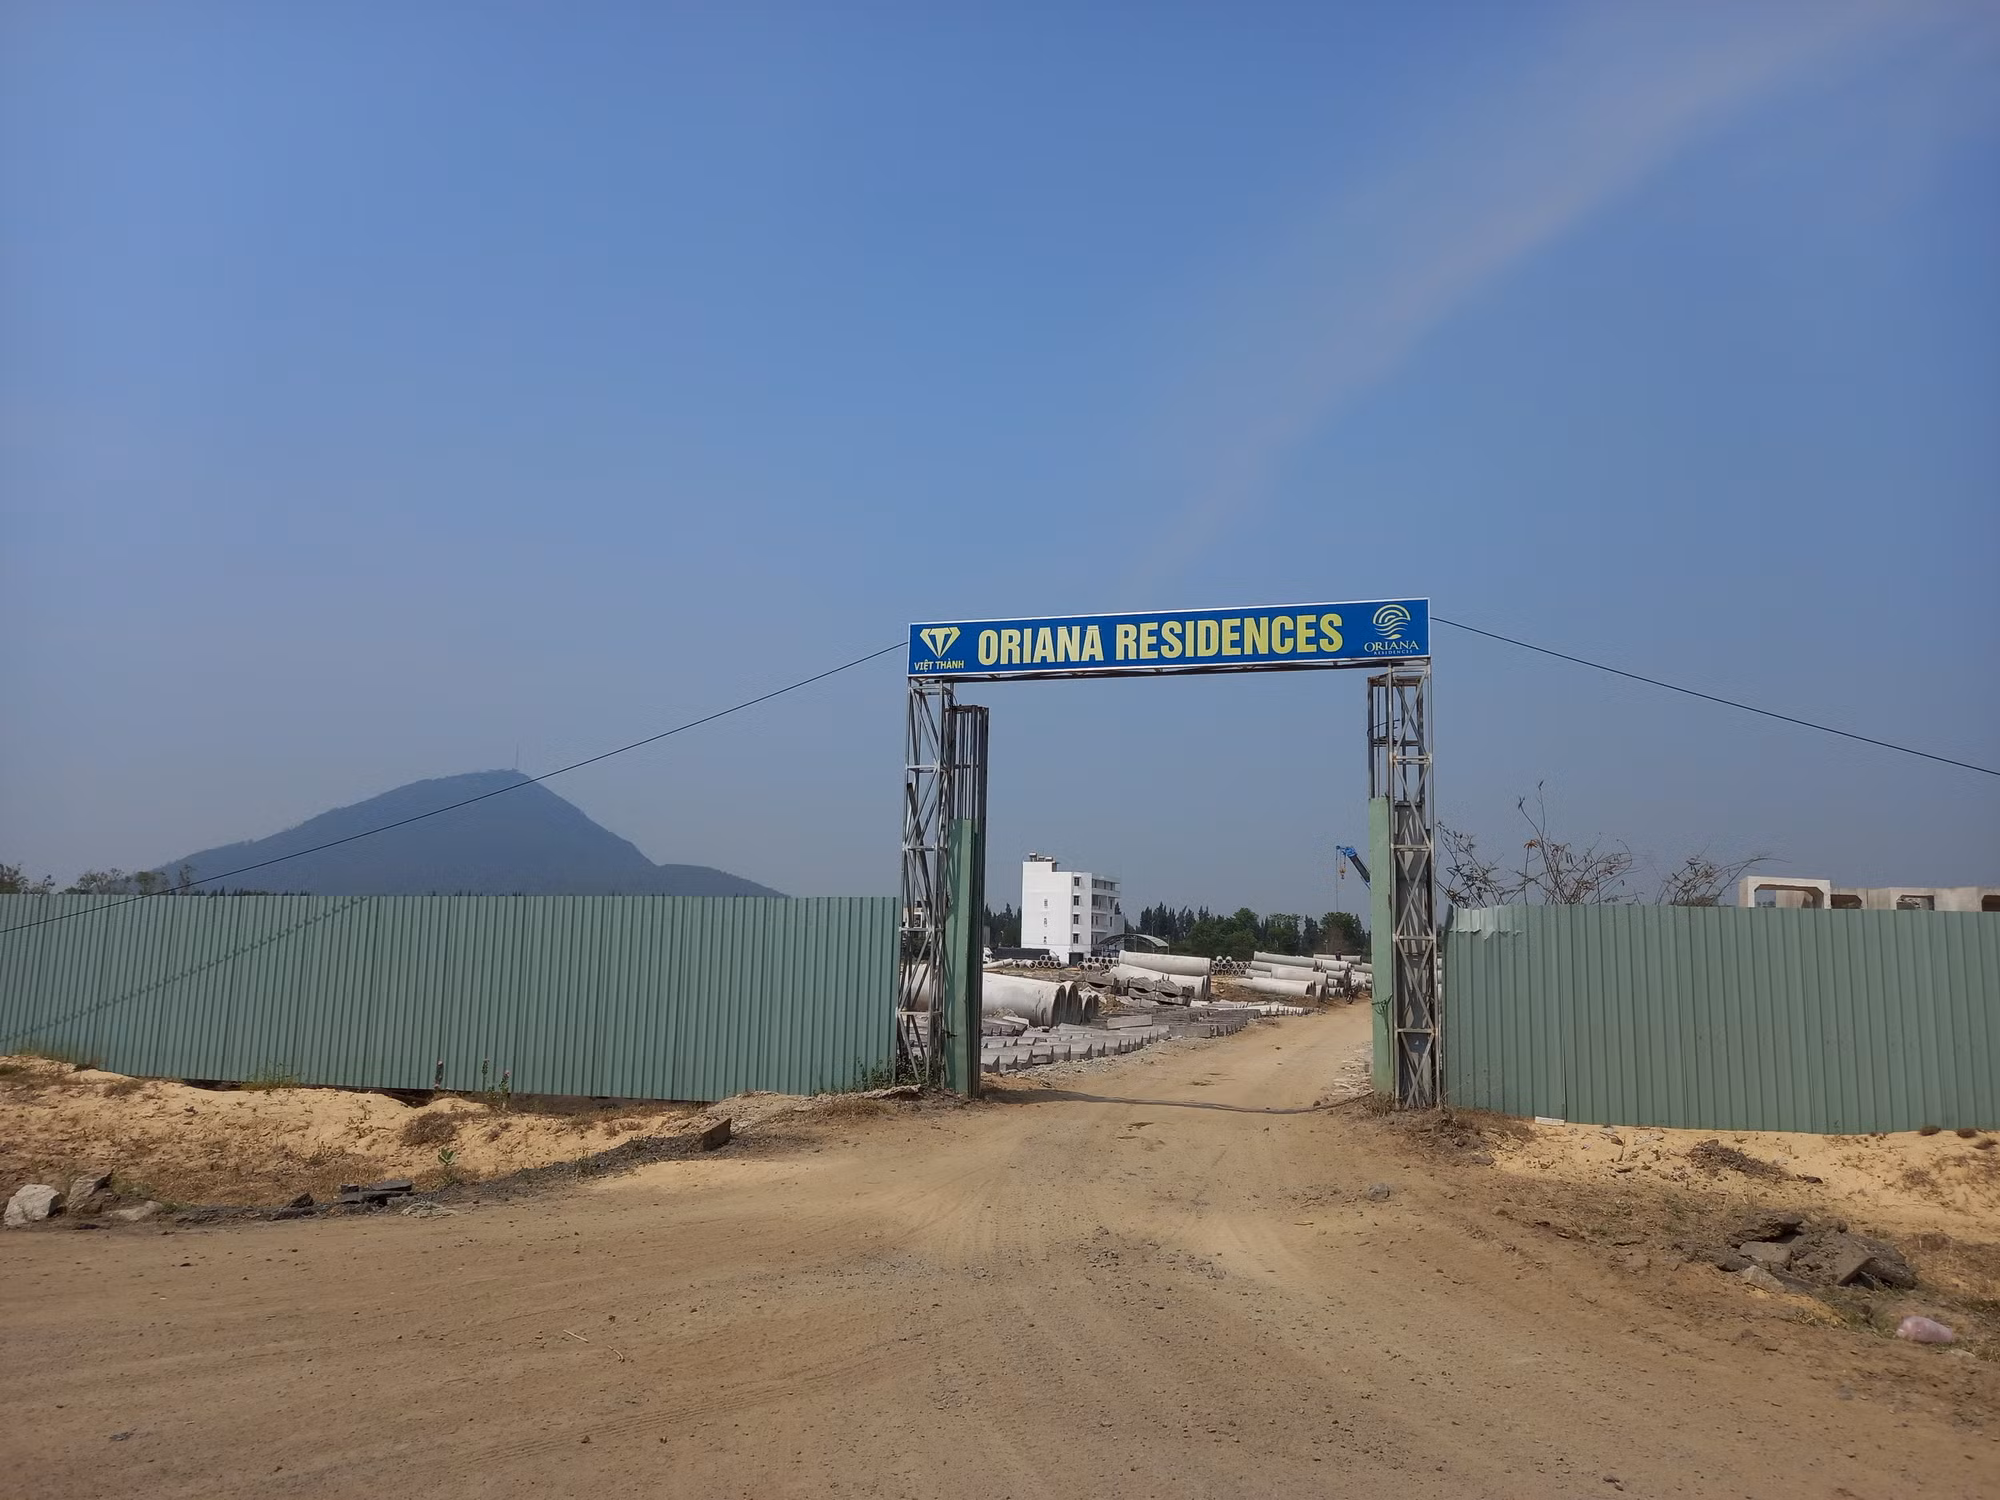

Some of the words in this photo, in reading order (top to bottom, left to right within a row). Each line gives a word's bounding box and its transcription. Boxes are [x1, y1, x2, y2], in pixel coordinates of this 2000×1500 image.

[978, 626, 1104, 666] ORIANA
[1116, 613, 1343, 661] RESIDENCES
[1364, 640, 1419, 652] ORIANA
[914, 659, 934, 672] VIỆT
[935, 658, 964, 670] THÀNH
